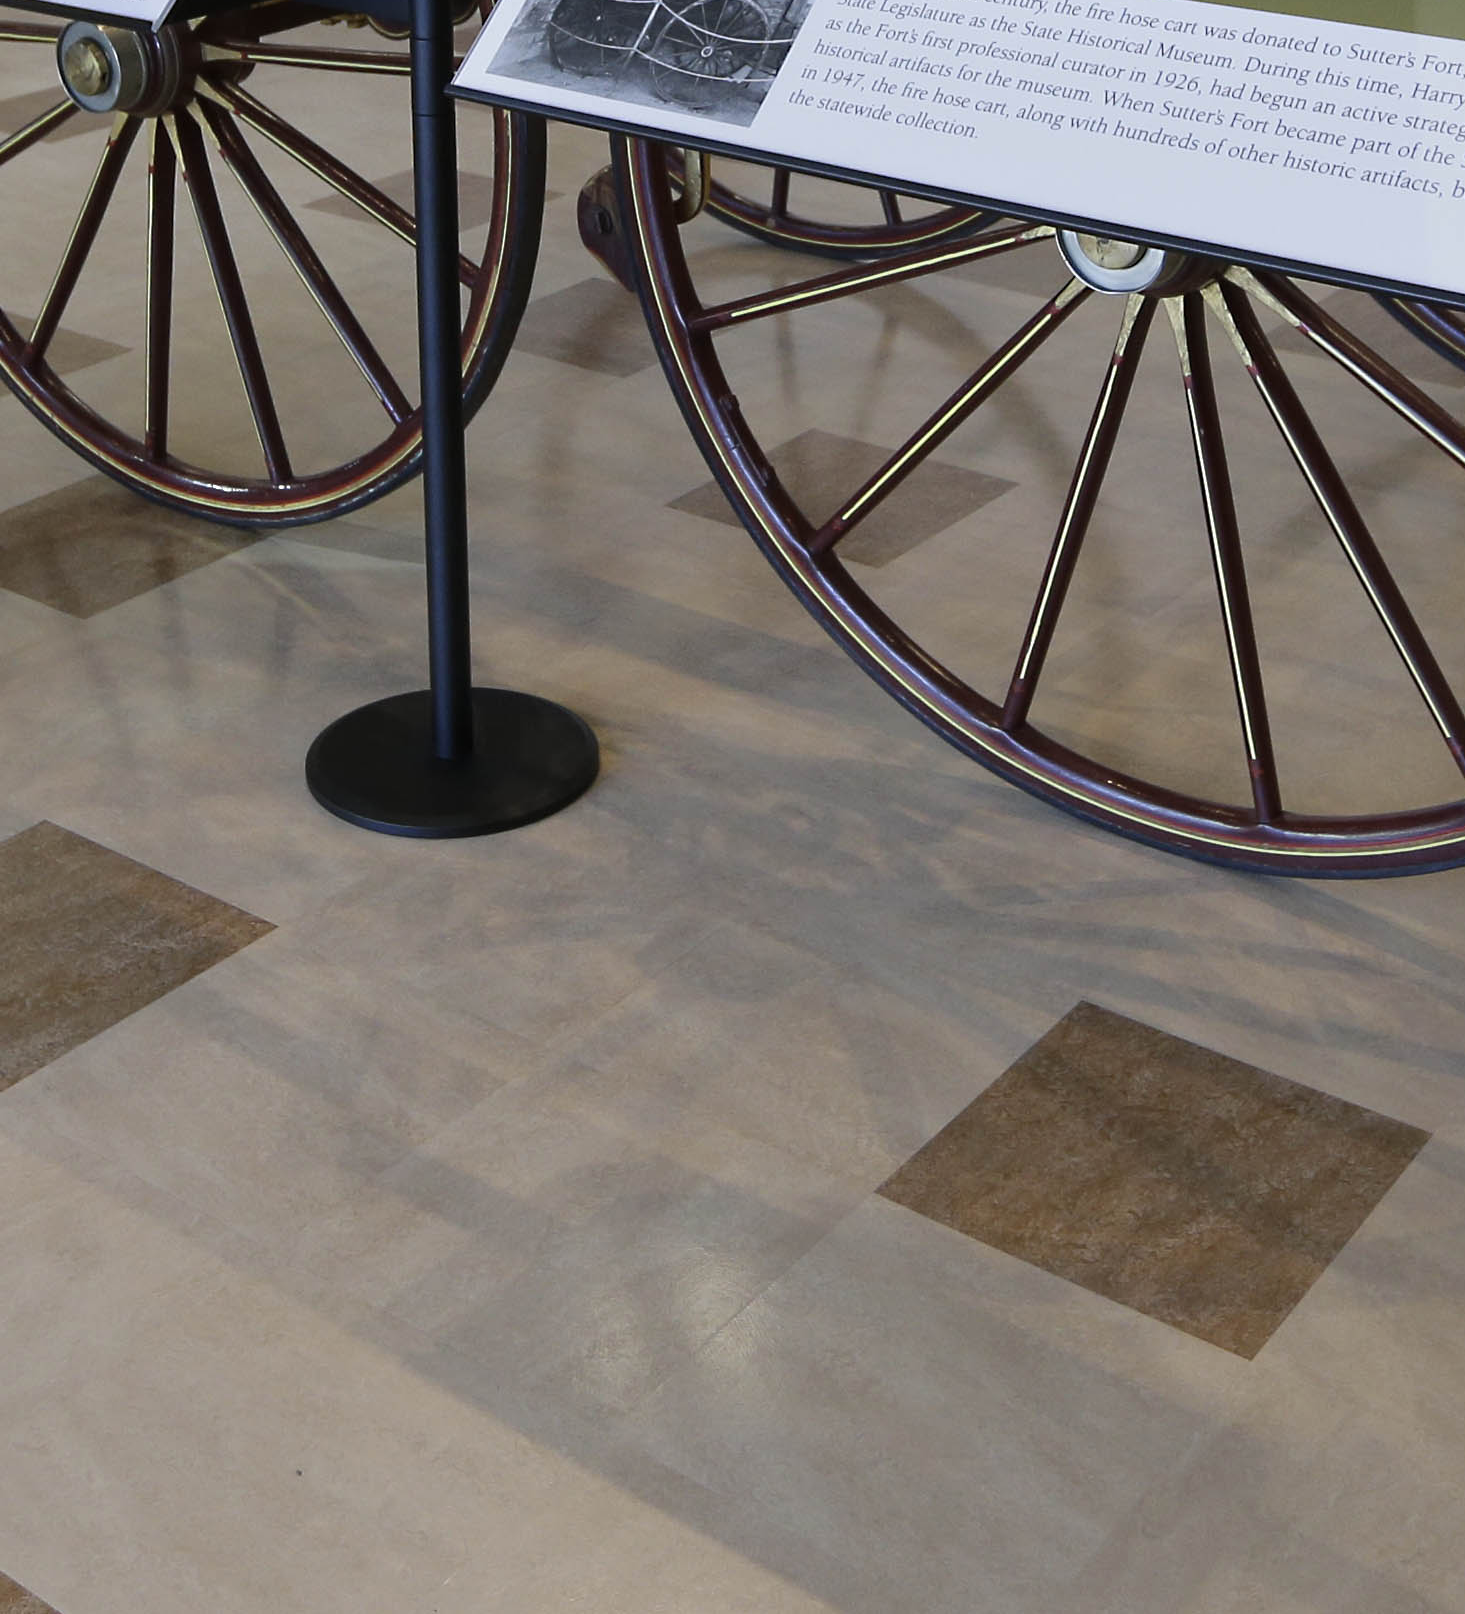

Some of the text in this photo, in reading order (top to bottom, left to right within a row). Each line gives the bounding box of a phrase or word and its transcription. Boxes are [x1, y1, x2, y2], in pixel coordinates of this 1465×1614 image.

[824, 18, 843, 31] as
[845, 17, 872, 37] the
[874, 23, 919, 45] Fort's
[920, 30, 954, 51] first
[954, 41, 1060, 69] professional
[1061, 59, 1127, 79] curator
[1128, 70, 1147, 84] in
[1153, 70, 1202, 96] 1926,
[1209, 77, 1247, 101] had
[1249, 84, 1308, 112] begun
[1311, 100, 1337, 116] an
[1340, 105, 1399, 126] active
[968, 16, 987, 29] as
[990, 15, 1018, 34] the
[1020, 20, 1063, 41] State
[1066, 27, 1153, 56] Historical
[1154, 41, 1236, 70] Museum.
[1243, 55, 1312, 87] During
[1314, 66, 1351, 88] this
[1355, 75, 1403, 99] time,
[1085, 2, 1115, 22] fire
[1118, 7, 1160, 29] hose
[1163, 19, 1198, 35] cart
[1204, 25, 1238, 41] was
[1241, 26, 1320, 54] donated
[1322, 42, 1342, 57] to
[1346, 43, 1417, 69] Sutter's
[788, 88, 978, 139] the statewide collection.
[800, 67, 818, 81] in
[822, 67, 866, 92] 1947,
[870, 76, 898, 95] the
[900, 81, 929, 101] fire
[931, 86, 971, 109] hose
[974, 99, 1010, 119] cart,
[1015, 103, 1066, 131] along
[1070, 116, 1108, 135] with
[1112, 119, 1201, 151] hundreds
[1203, 137, 1229, 156] of
[1227, 143, 1280, 165] other
[1282, 149, 1357, 180] historic
[1359, 169, 1443, 198] artifacts,
[813, 37, 889, 66] historical
[888, 56, 954, 78] artifacts
[956, 63, 983, 83] for
[984, 69, 1013, 89] the
[1015, 78, 1093, 104] museum.
[1104, 89, 1155, 114] When
[1159, 100, 1225, 126] Sutter's
[1229, 111, 1270, 134] Fort
[1273, 117, 1347, 147] became
[1349, 137, 1392, 155] part
[1397, 141, 1423, 160] of
[1422, 144, 1456, 166] the
